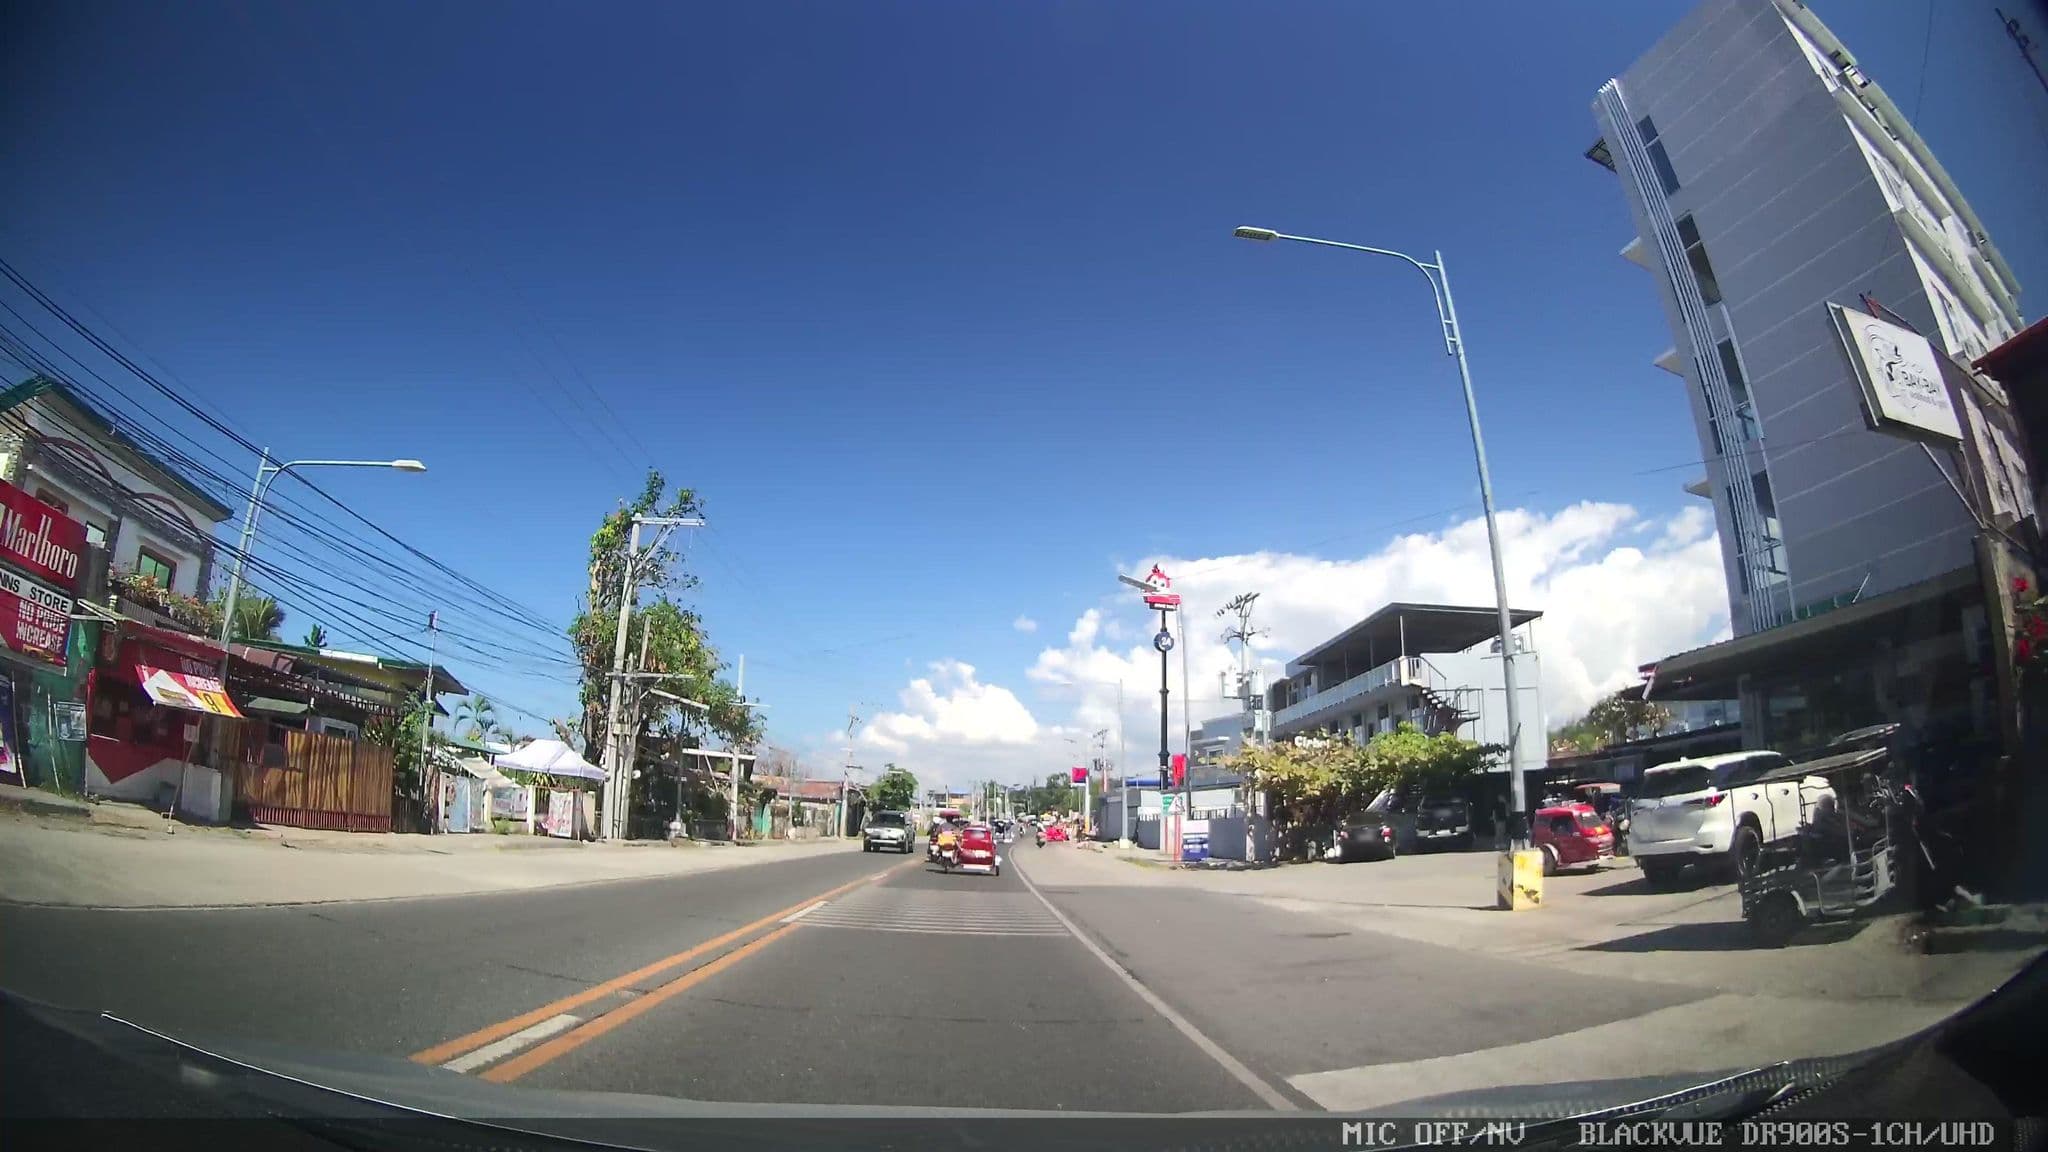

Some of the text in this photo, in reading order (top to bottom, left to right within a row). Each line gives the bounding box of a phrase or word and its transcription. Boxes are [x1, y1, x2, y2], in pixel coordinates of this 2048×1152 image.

[1, 509, 78, 580] Marlboro
[29, 586, 68, 613] STORE
[18, 599, 66, 635] NO PRICE
[15, 620, 64, 653] INCREASE
